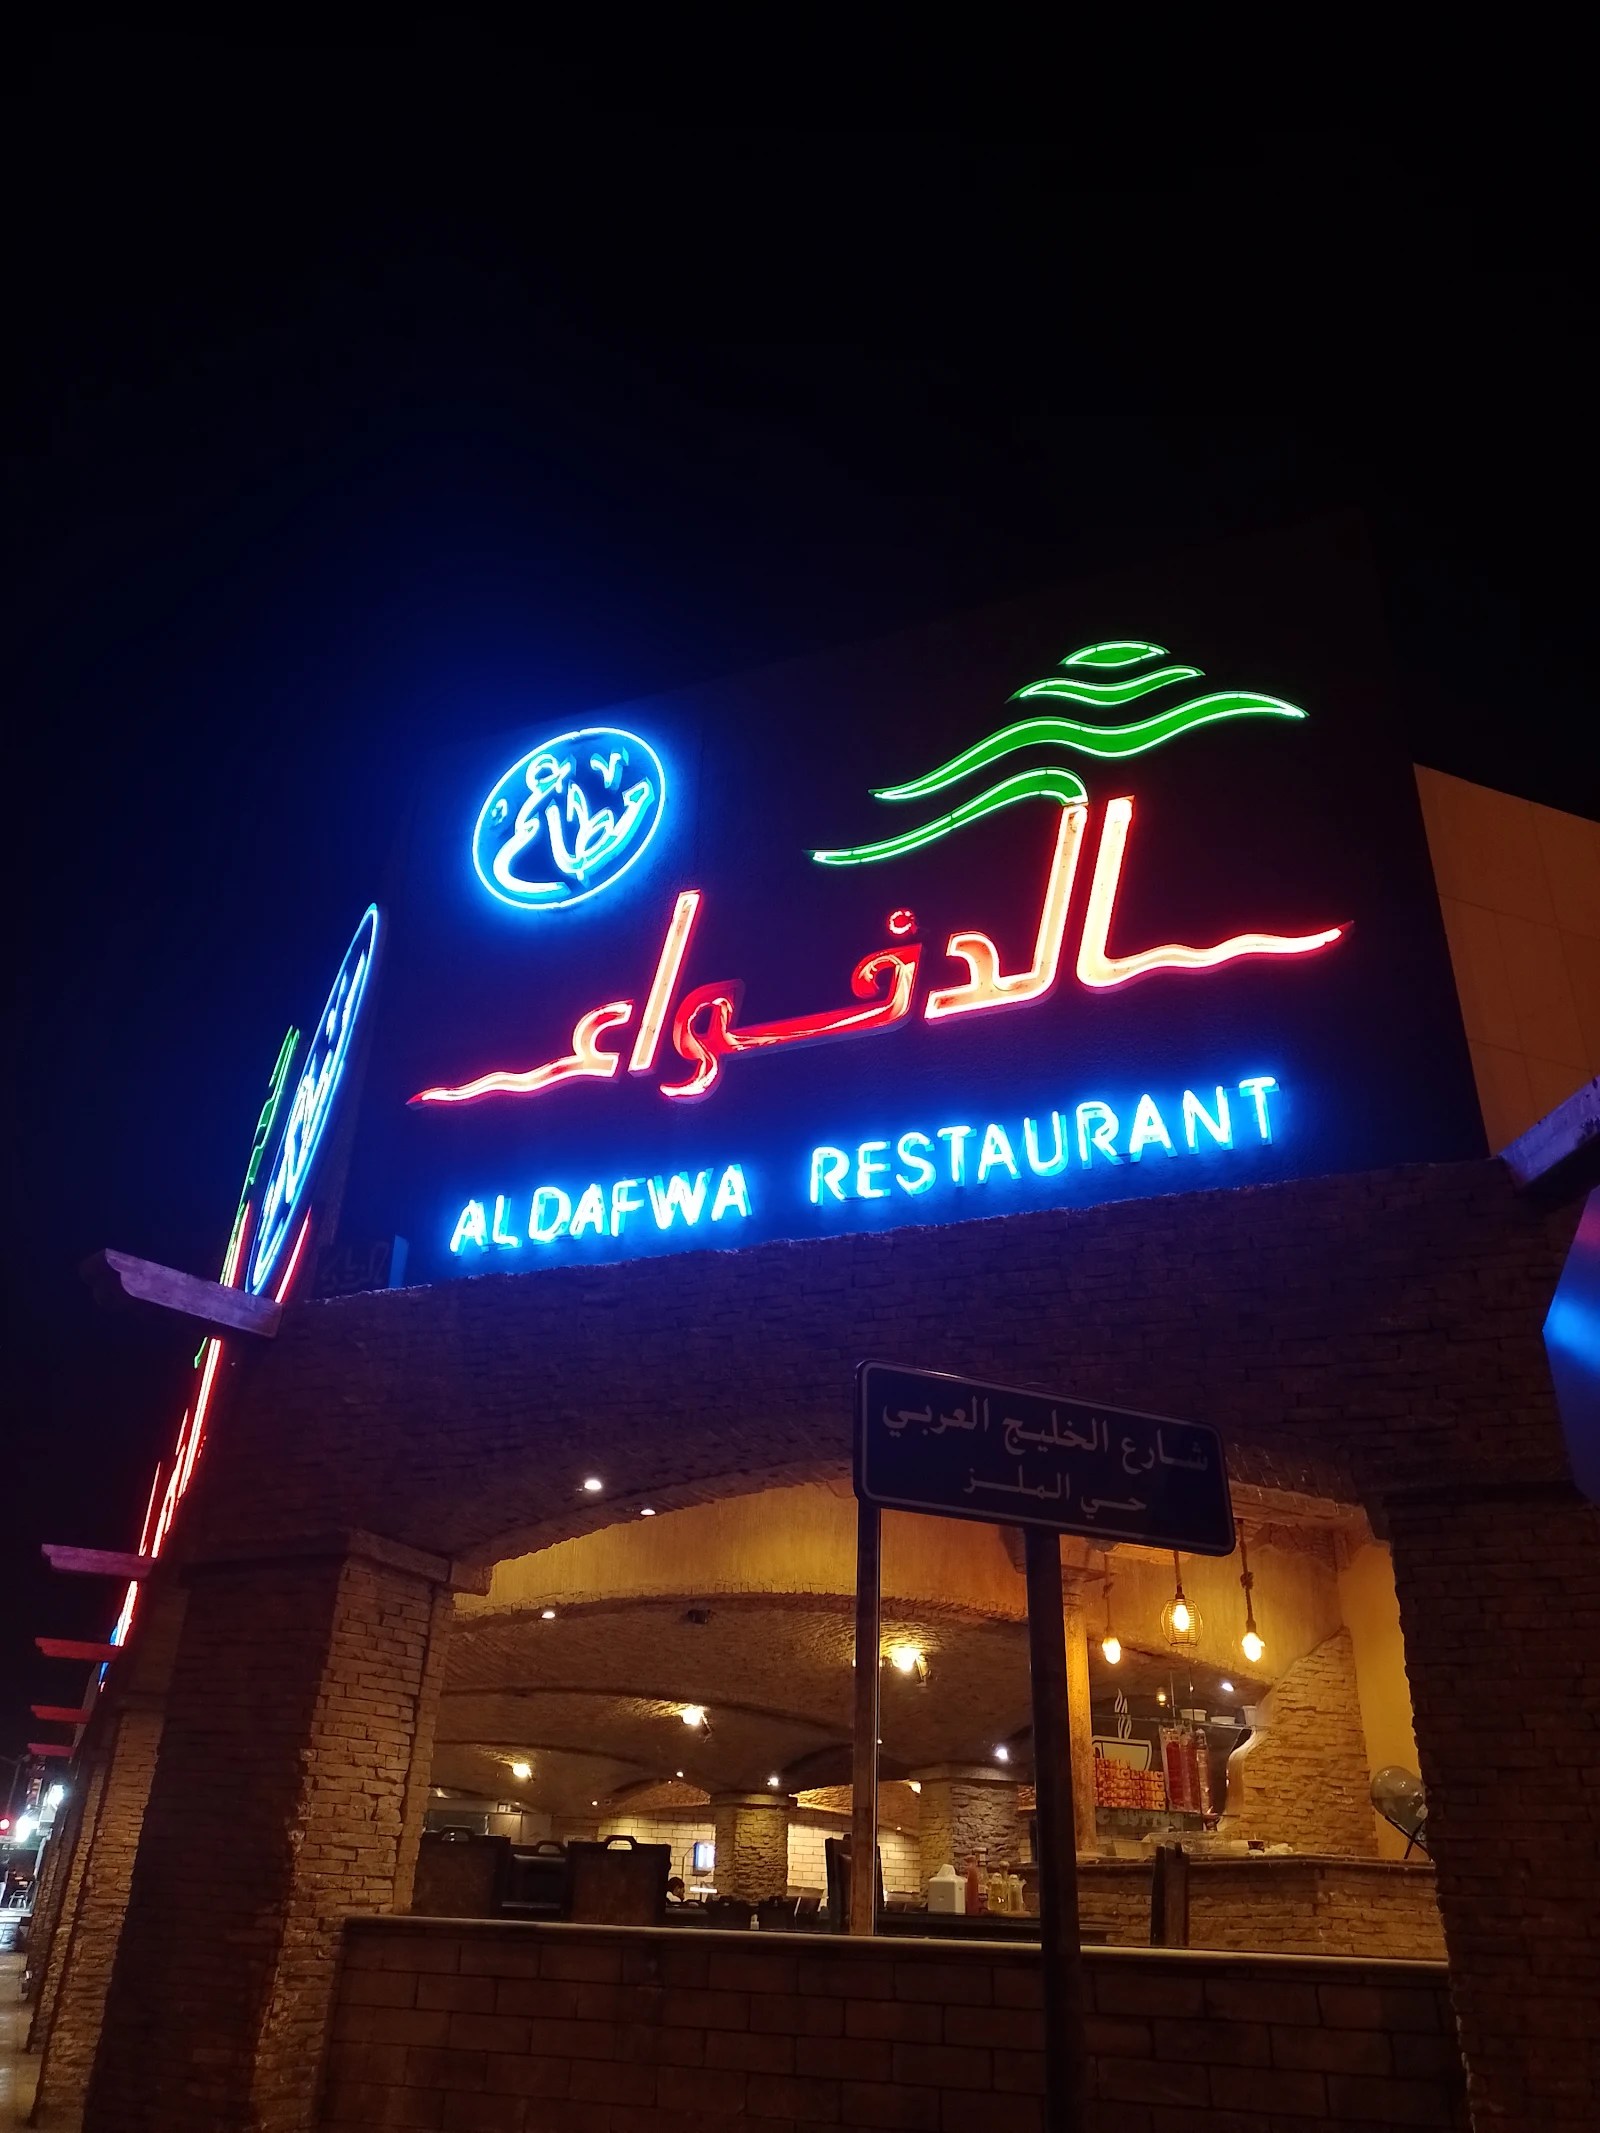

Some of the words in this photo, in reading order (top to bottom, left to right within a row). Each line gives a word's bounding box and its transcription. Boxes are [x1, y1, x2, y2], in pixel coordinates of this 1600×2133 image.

[810, 1076, 1278, 1205] RESTAURANT
[882, 1396, 989, 1438] العربي
[1002, 1410, 1109, 1456] الخليج
[1121, 1428, 1208, 1475] شارع
[964, 1465, 1071, 1501] الملز
[1080, 1494, 1147, 1519] حي
